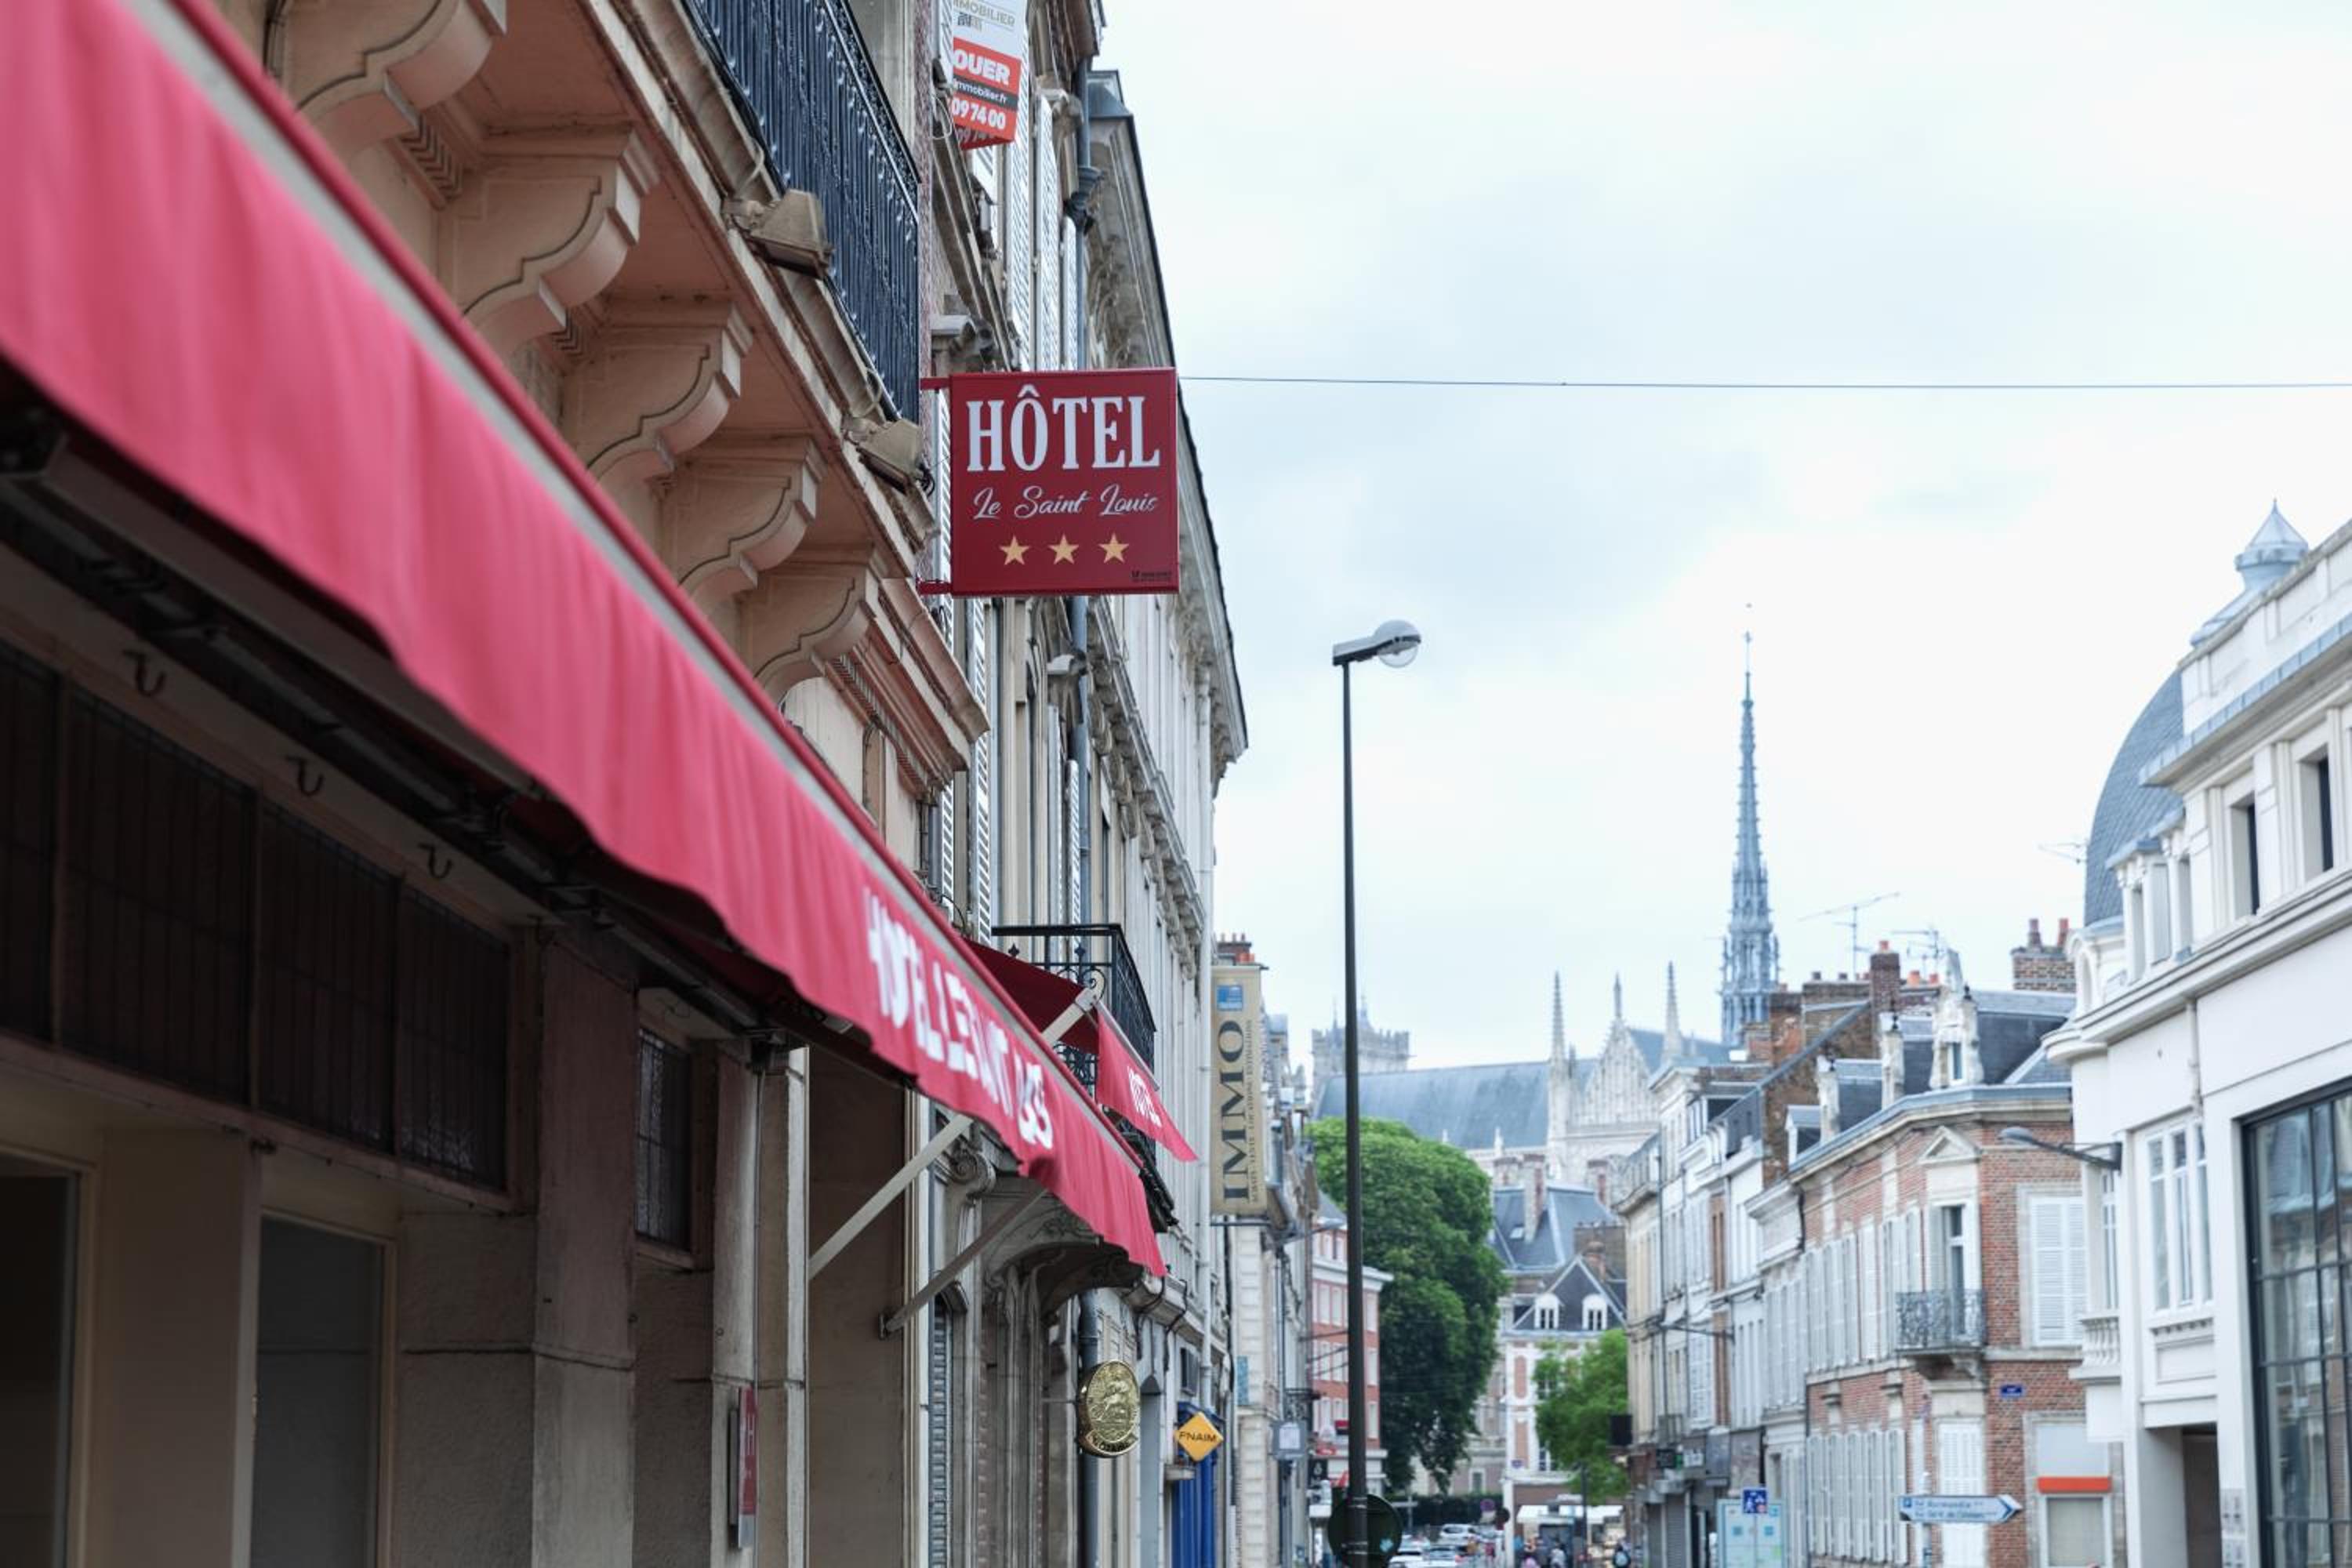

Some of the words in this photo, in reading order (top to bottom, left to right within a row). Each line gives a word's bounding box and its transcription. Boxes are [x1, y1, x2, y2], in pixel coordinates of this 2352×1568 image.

[953, 49, 1011, 86] OUER
[988, 109, 1007, 129] 00
[966, 384, 1160, 471] HÔTEL
[973, 487, 1001, 520] Le
[1014, 485, 1091, 519] Saint
[1100, 484, 1159, 516] Louis
[1218, 1021, 1250, 1200] IMMO
[1179, 1431, 1216, 1443] FNAIM
